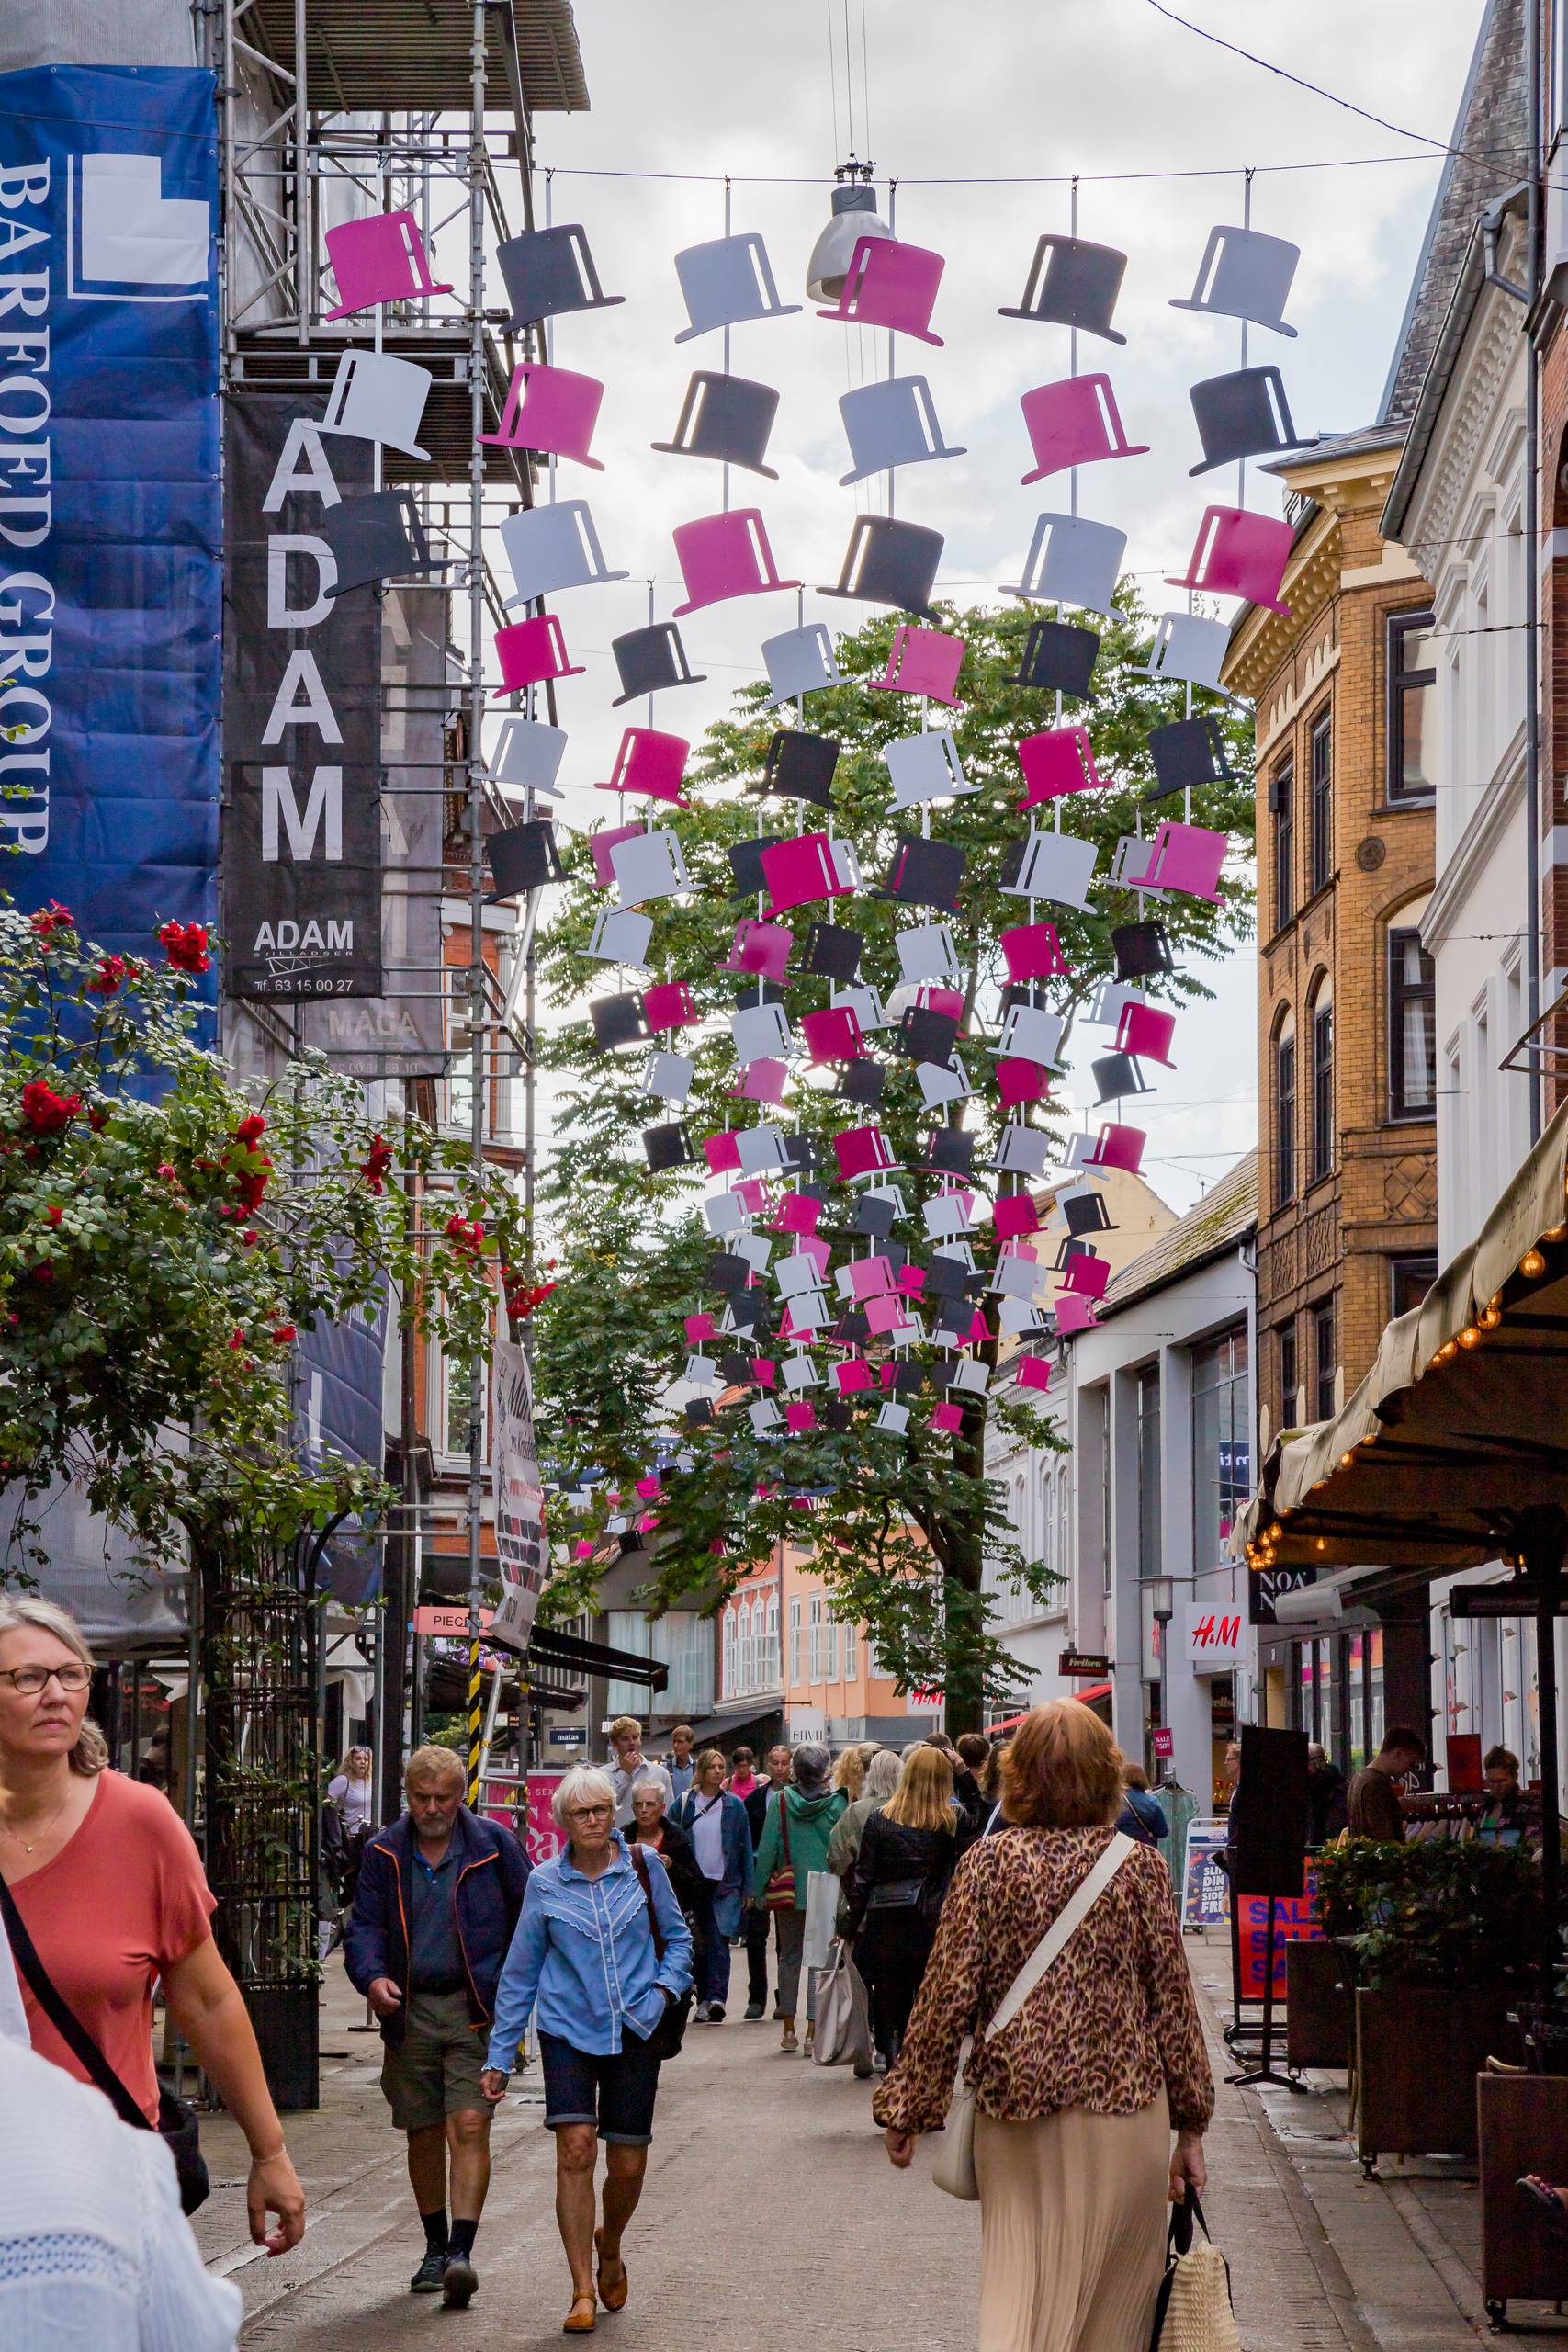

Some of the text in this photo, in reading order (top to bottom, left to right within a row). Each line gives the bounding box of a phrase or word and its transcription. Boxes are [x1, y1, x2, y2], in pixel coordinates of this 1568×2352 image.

[0, 156, 56, 855] BARFOED GROUP
[261, 418, 344, 862] ADAM
[254, 920, 354, 951] ADAM
[254, 979, 354, 992] Tlf. 63 15 00 27
[1259, 1571, 1305, 1590] NOA
[434, 1615, 469, 1628] PIEC
[1191, 1615, 1241, 1648] H&M
[536, 1787, 556, 1797] SEX
[1202, 1875, 1224, 1886] DIN
